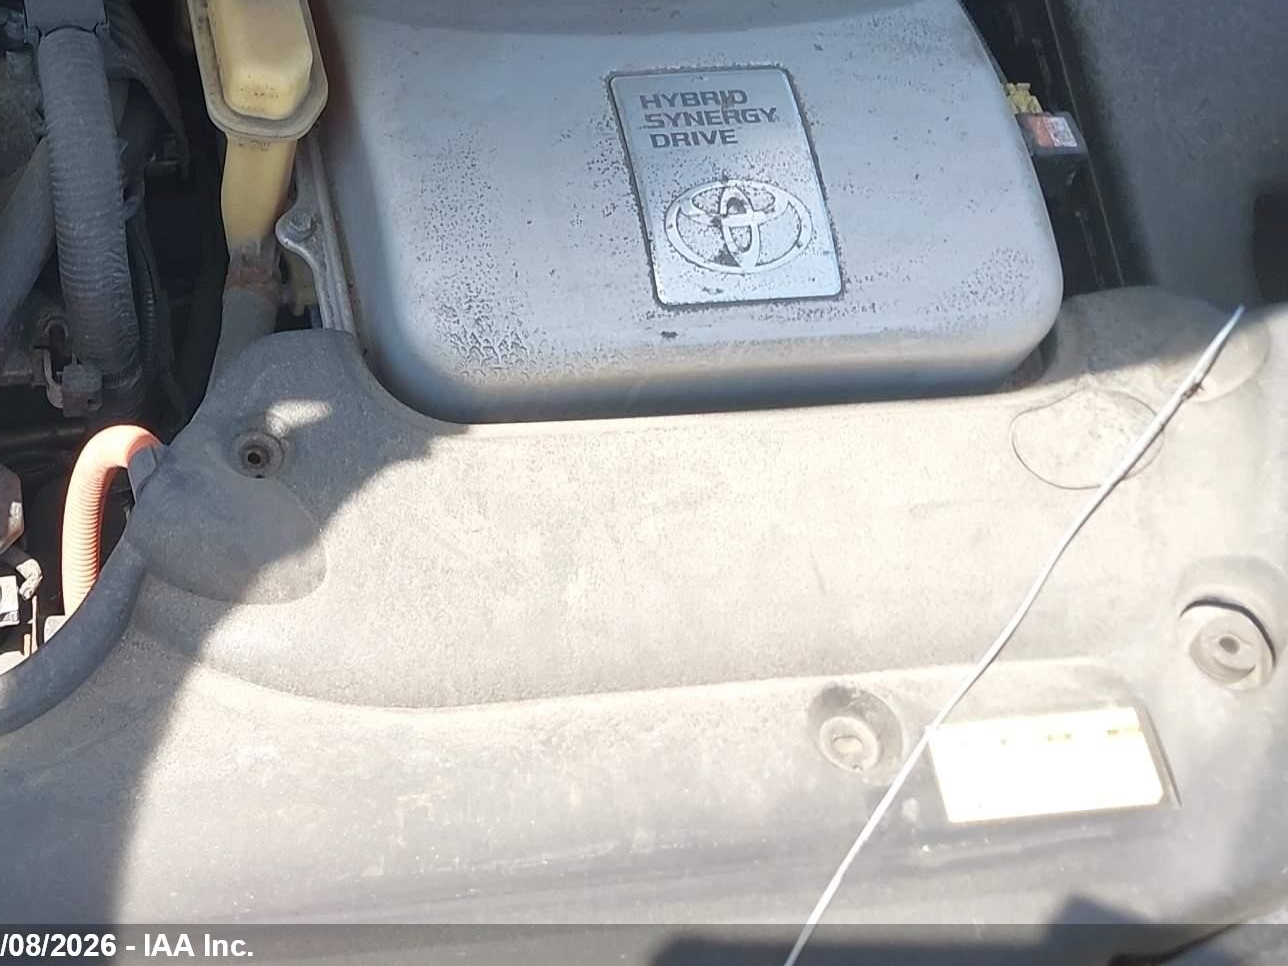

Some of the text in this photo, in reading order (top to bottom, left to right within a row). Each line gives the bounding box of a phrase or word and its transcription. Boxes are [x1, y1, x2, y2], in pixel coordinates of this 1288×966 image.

[639, 89, 748, 108] HYBRID
[644, 107, 778, 129] SYNERGY
[649, 130, 738, 148] DRIVE
